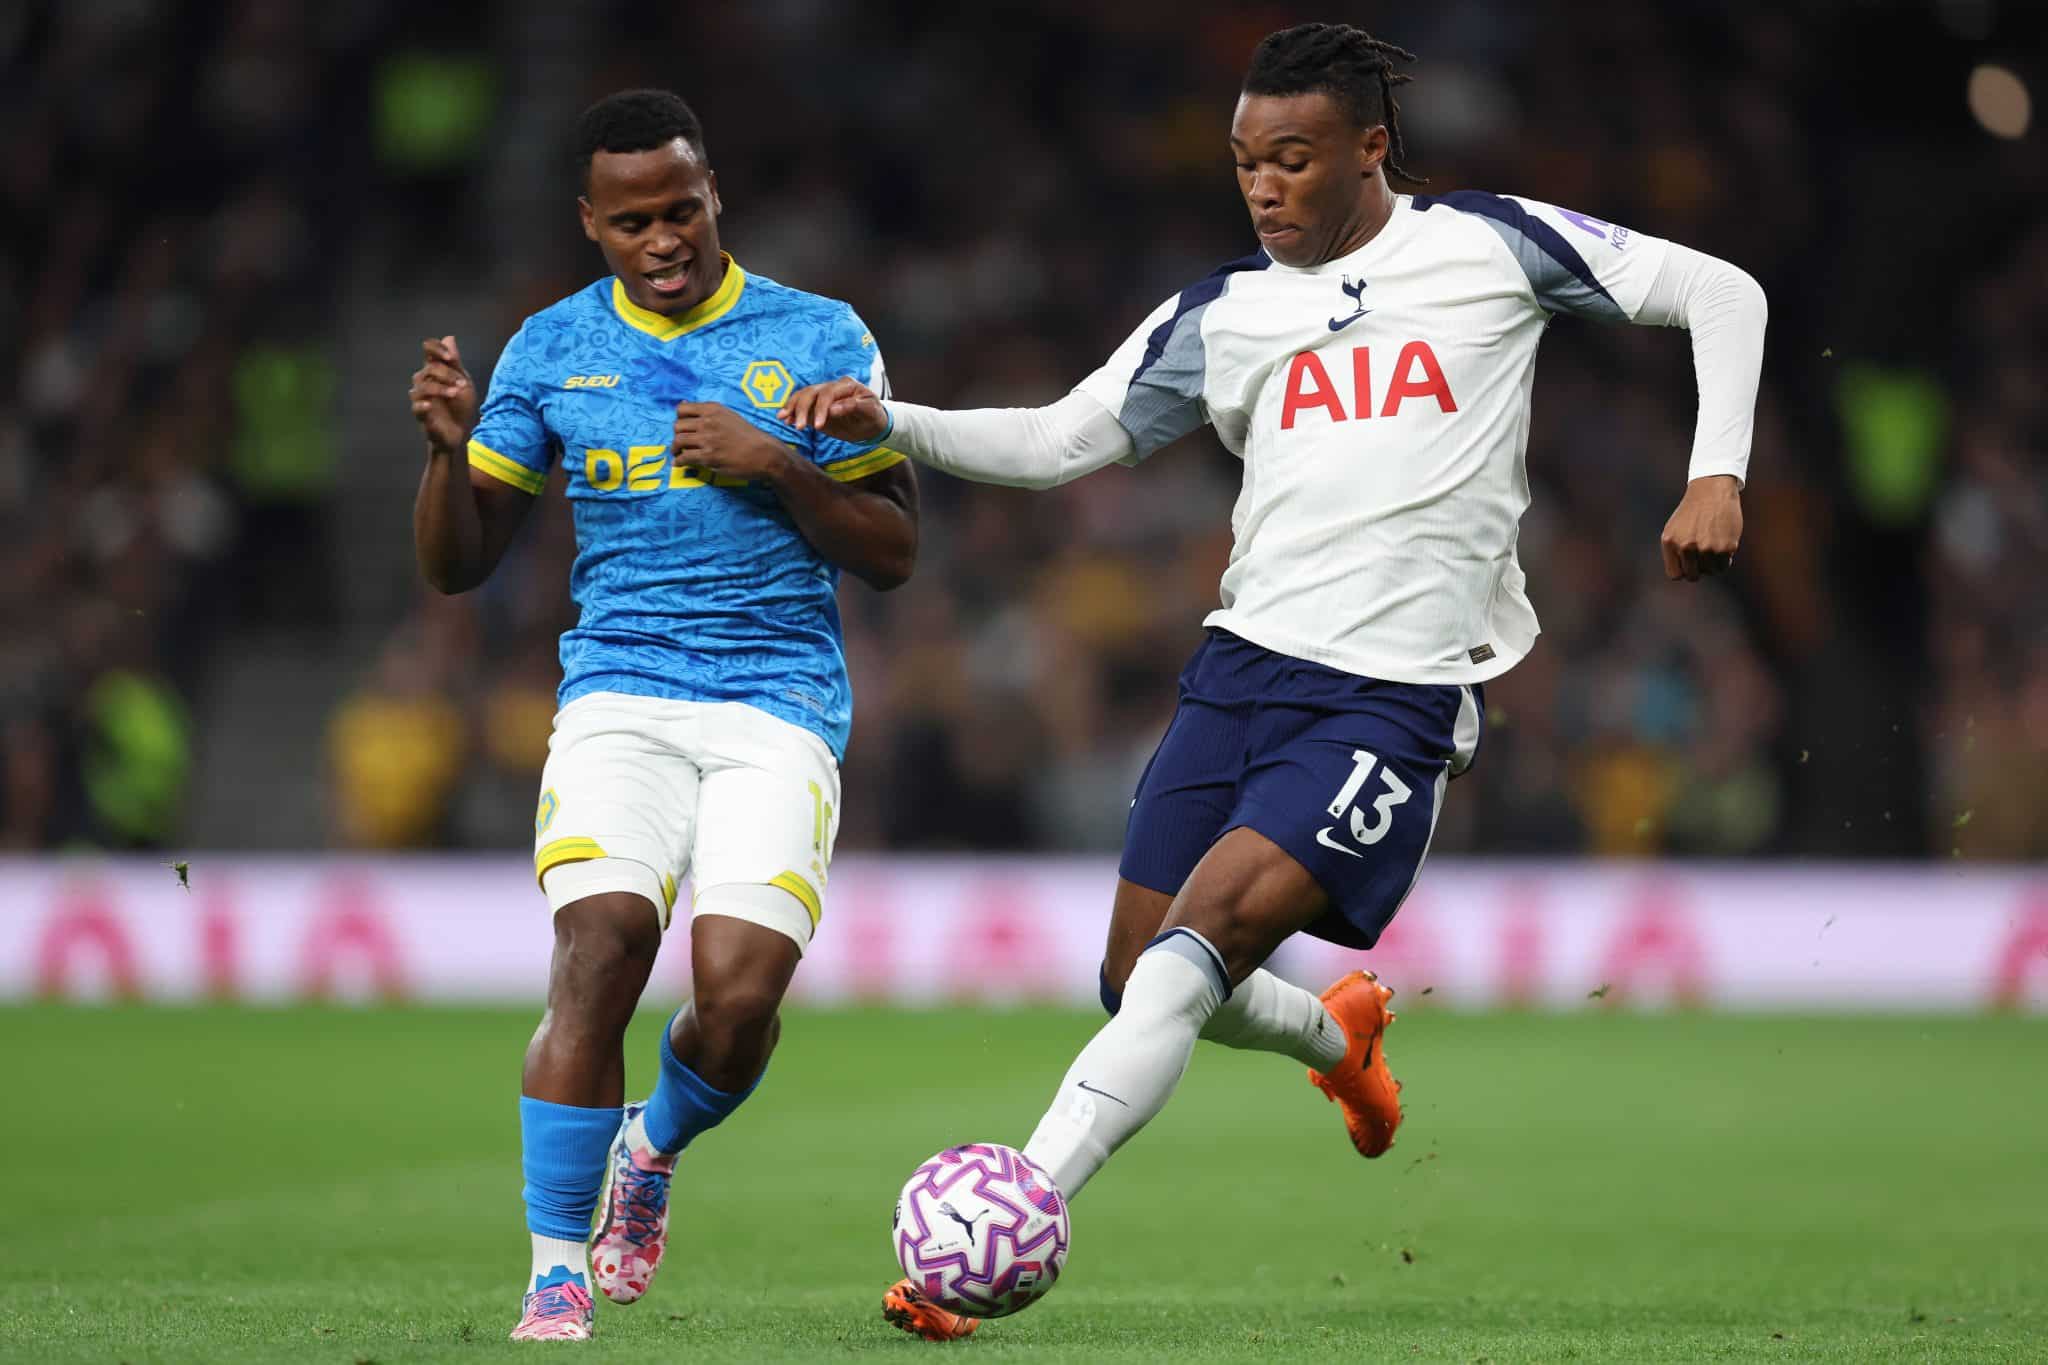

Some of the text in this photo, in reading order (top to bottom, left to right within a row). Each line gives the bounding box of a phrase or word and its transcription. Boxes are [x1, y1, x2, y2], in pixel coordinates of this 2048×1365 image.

[1610, 225, 1630, 251] kra
[562, 374, 621, 390] SUDU
[1280, 340, 1459, 430] AIA
[1326, 749, 1414, 846] 13
